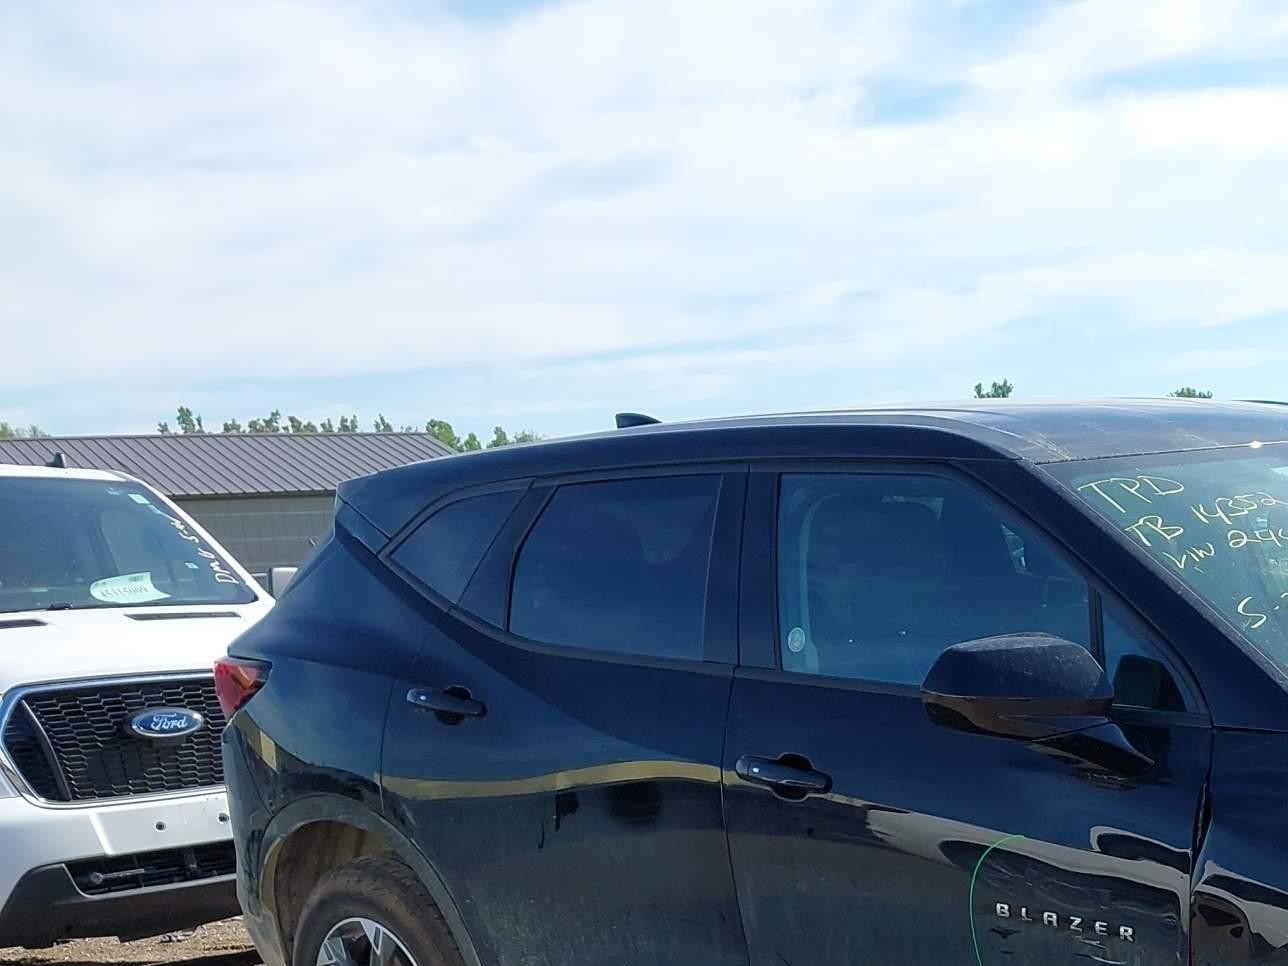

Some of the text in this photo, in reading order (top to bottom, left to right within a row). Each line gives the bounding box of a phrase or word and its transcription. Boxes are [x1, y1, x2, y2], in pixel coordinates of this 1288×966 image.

[1077, 475, 1185, 514] TPD
[1124, 515, 1185, 547] TB
[150, 712, 188, 731] Ford
[995, 902, 1135, 943] BLAZER
